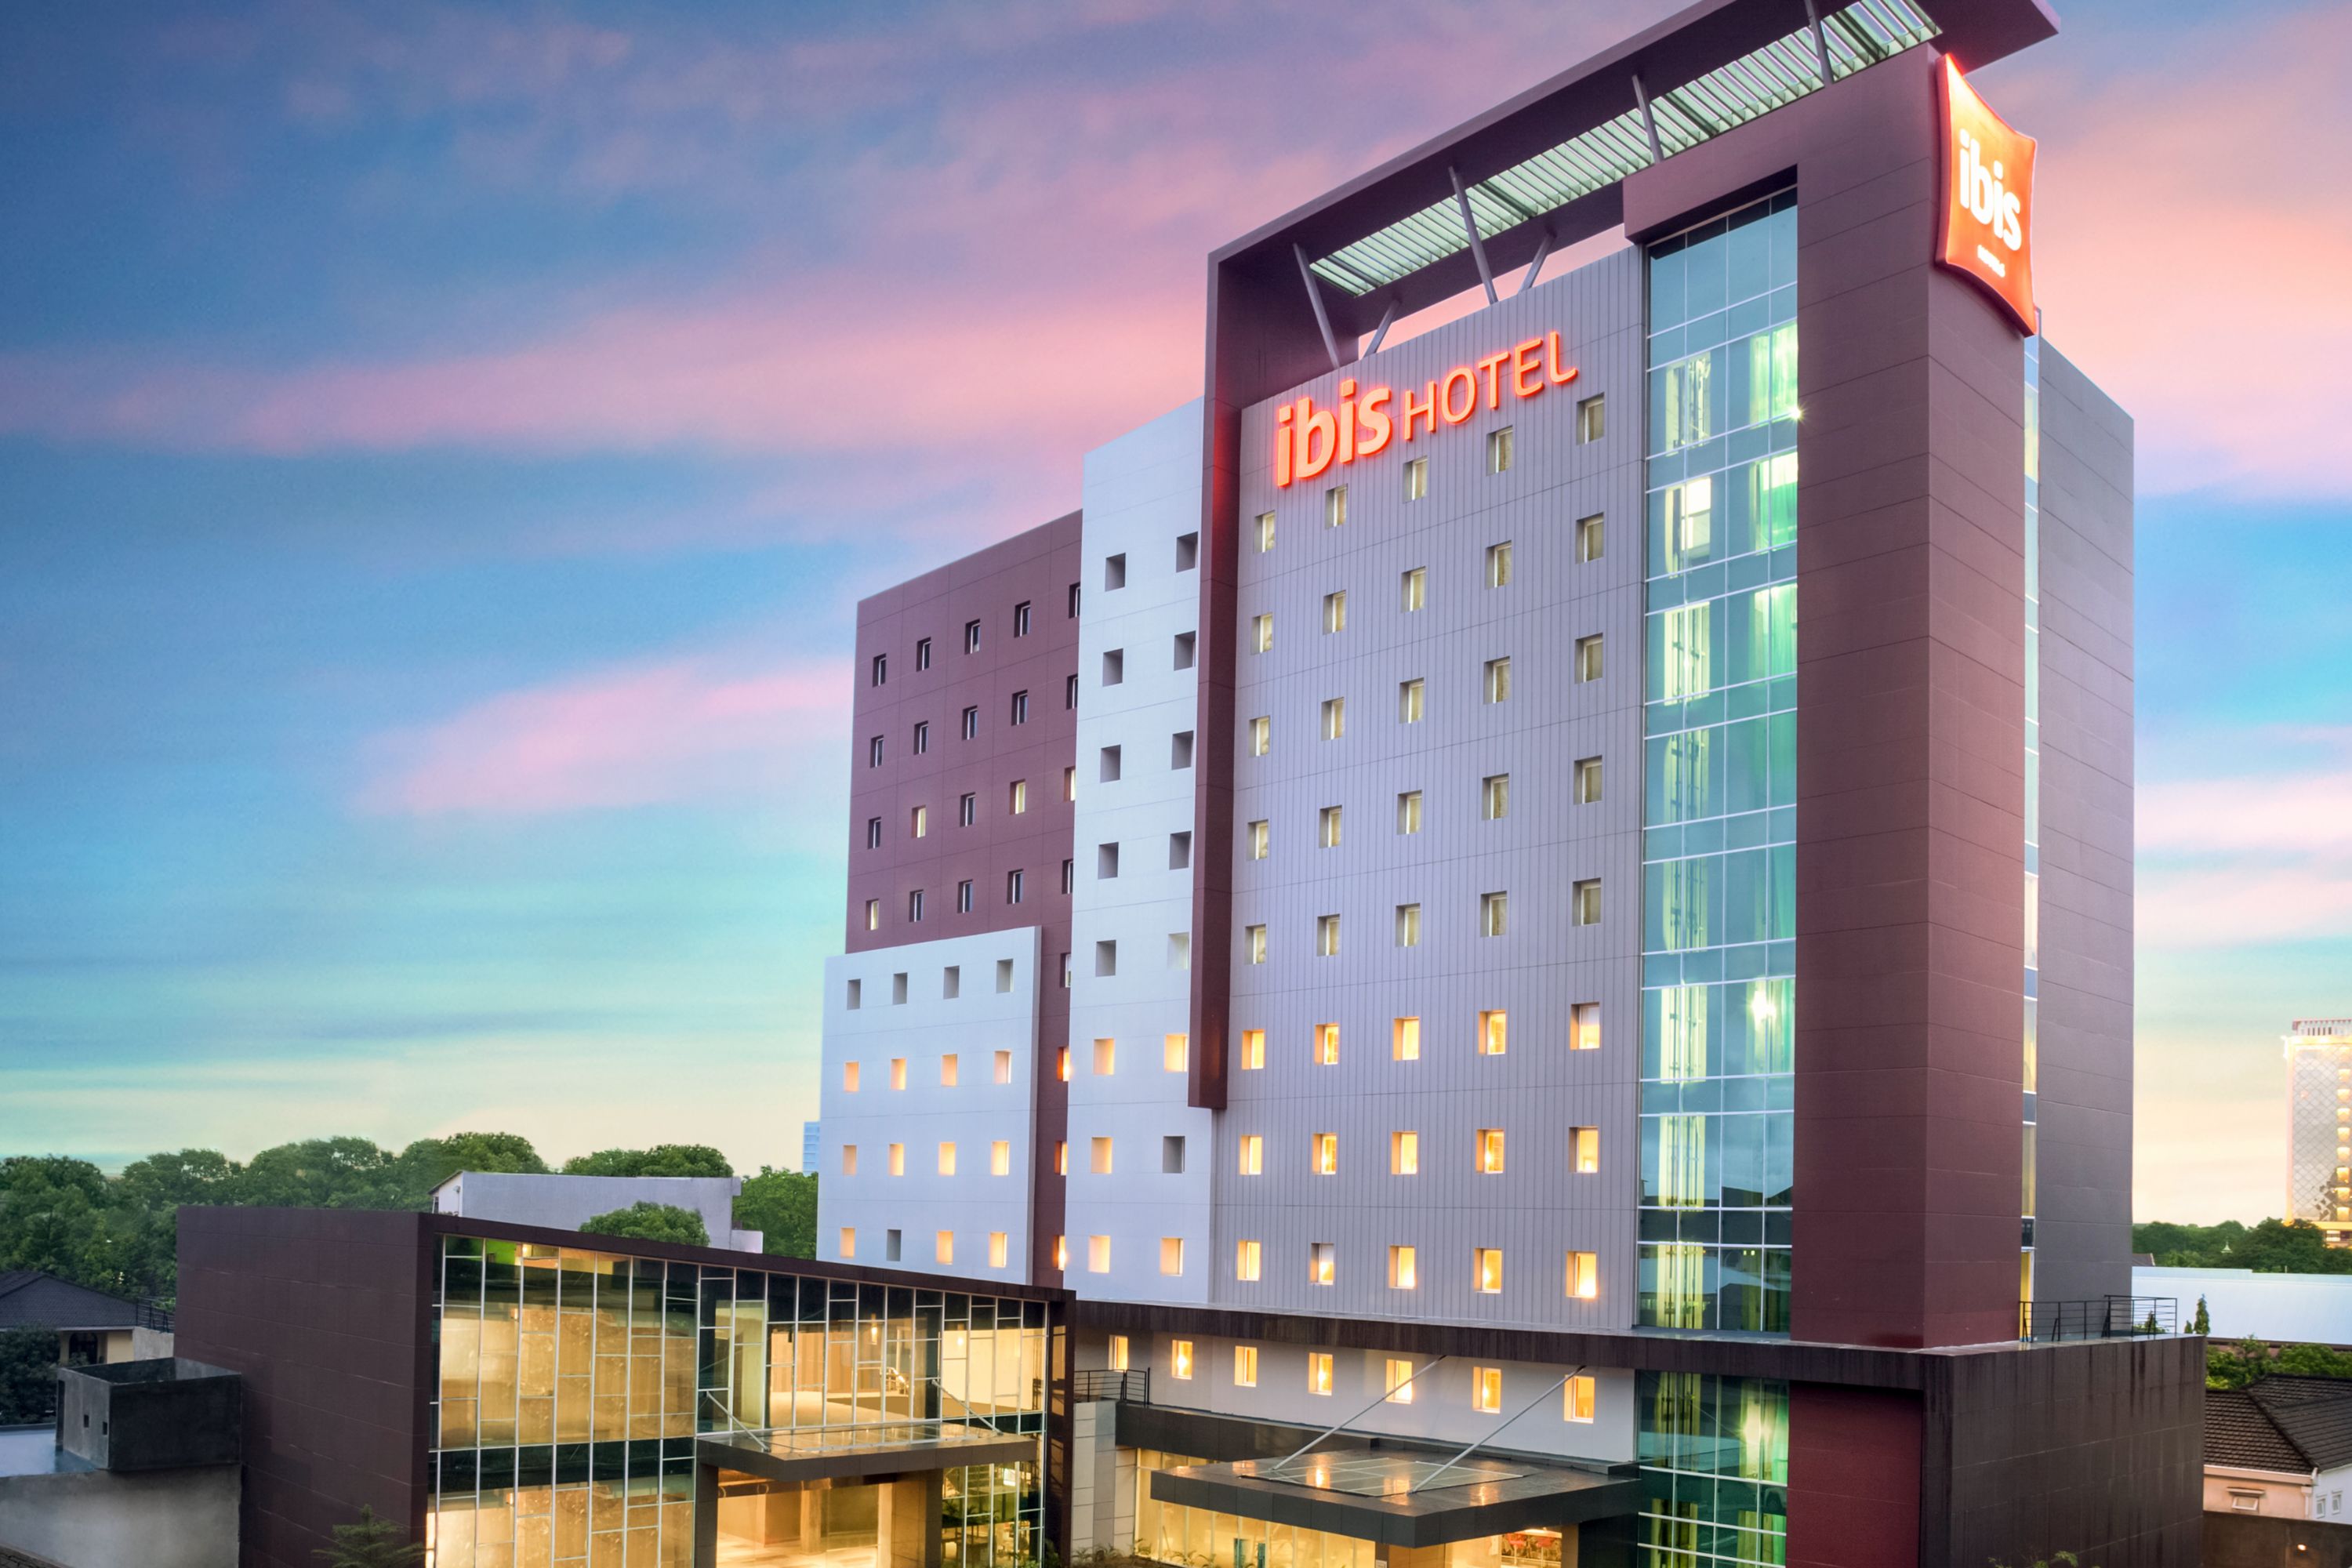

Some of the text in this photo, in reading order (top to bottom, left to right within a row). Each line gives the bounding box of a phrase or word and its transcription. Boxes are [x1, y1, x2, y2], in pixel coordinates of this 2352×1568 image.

[1960, 129, 2022, 251] ibis
[1276, 331, 1578, 488] ibis HOTEL
